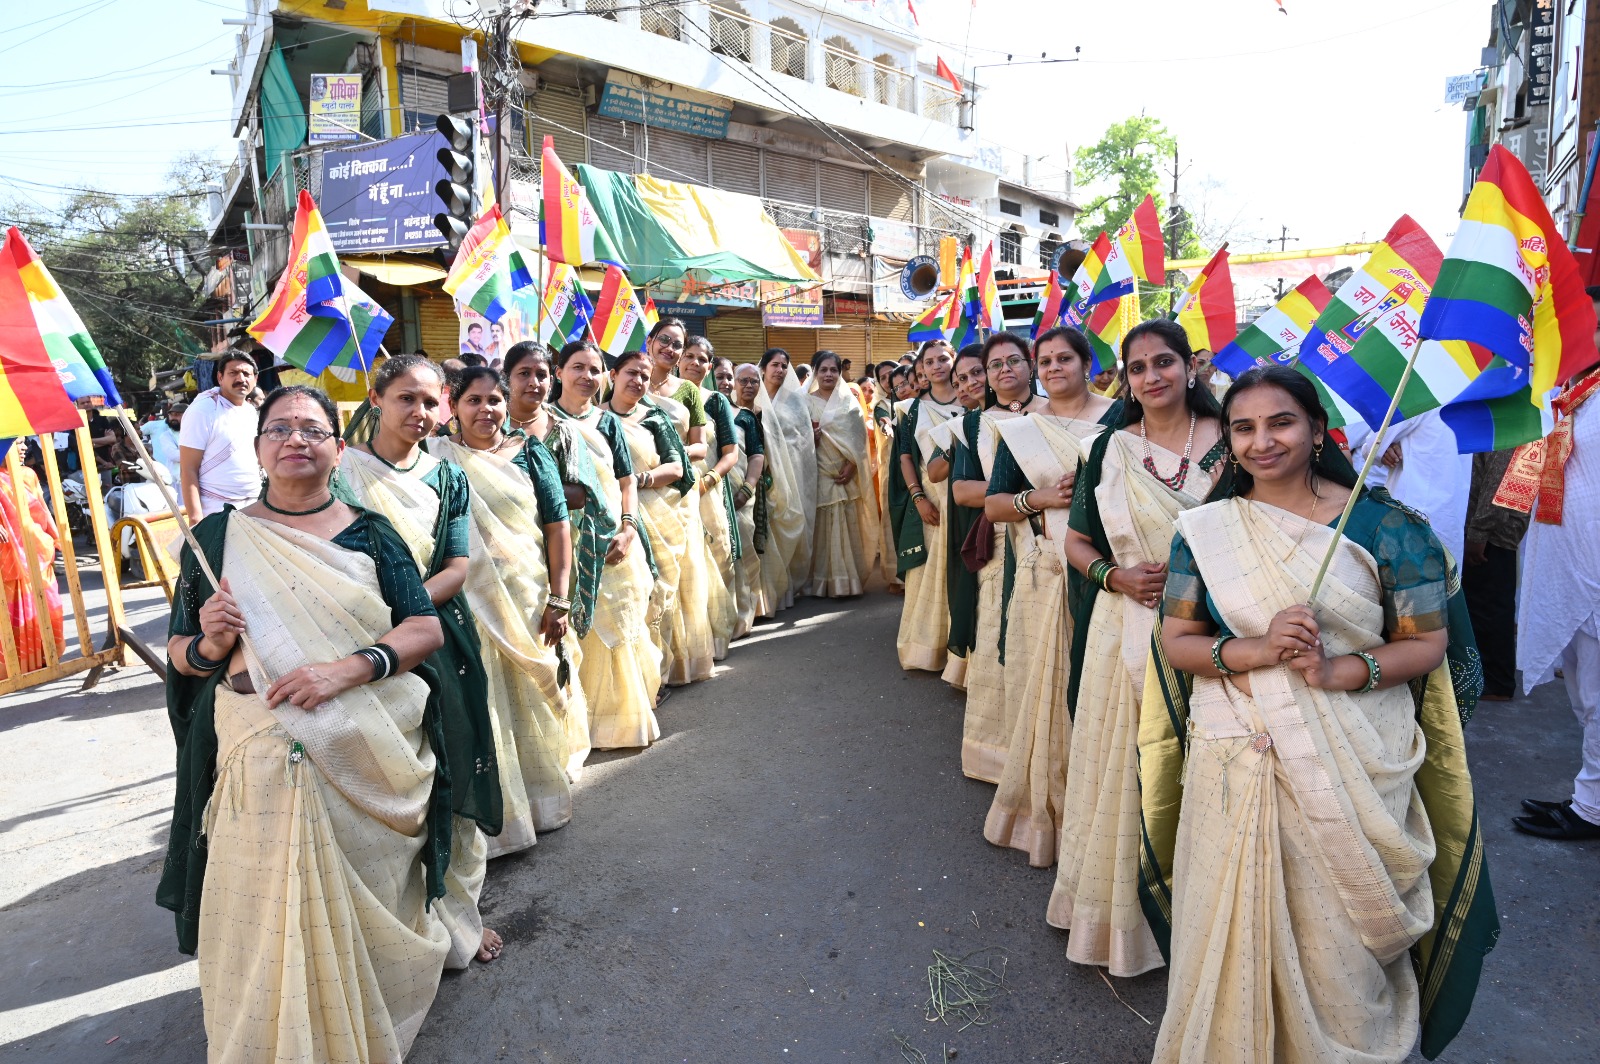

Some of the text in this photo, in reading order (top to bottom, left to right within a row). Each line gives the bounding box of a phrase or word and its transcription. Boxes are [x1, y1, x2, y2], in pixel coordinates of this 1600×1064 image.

[330, 77, 359, 100] राधिका
[330, 161, 350, 179] कोई
[369, 183, 379, 201] मैं
[404, 215, 420, 227] महेन्द्र
[1353, 285, 1419, 350] जय जिनेन्द्र
[1280, 327, 1297, 342] जय
